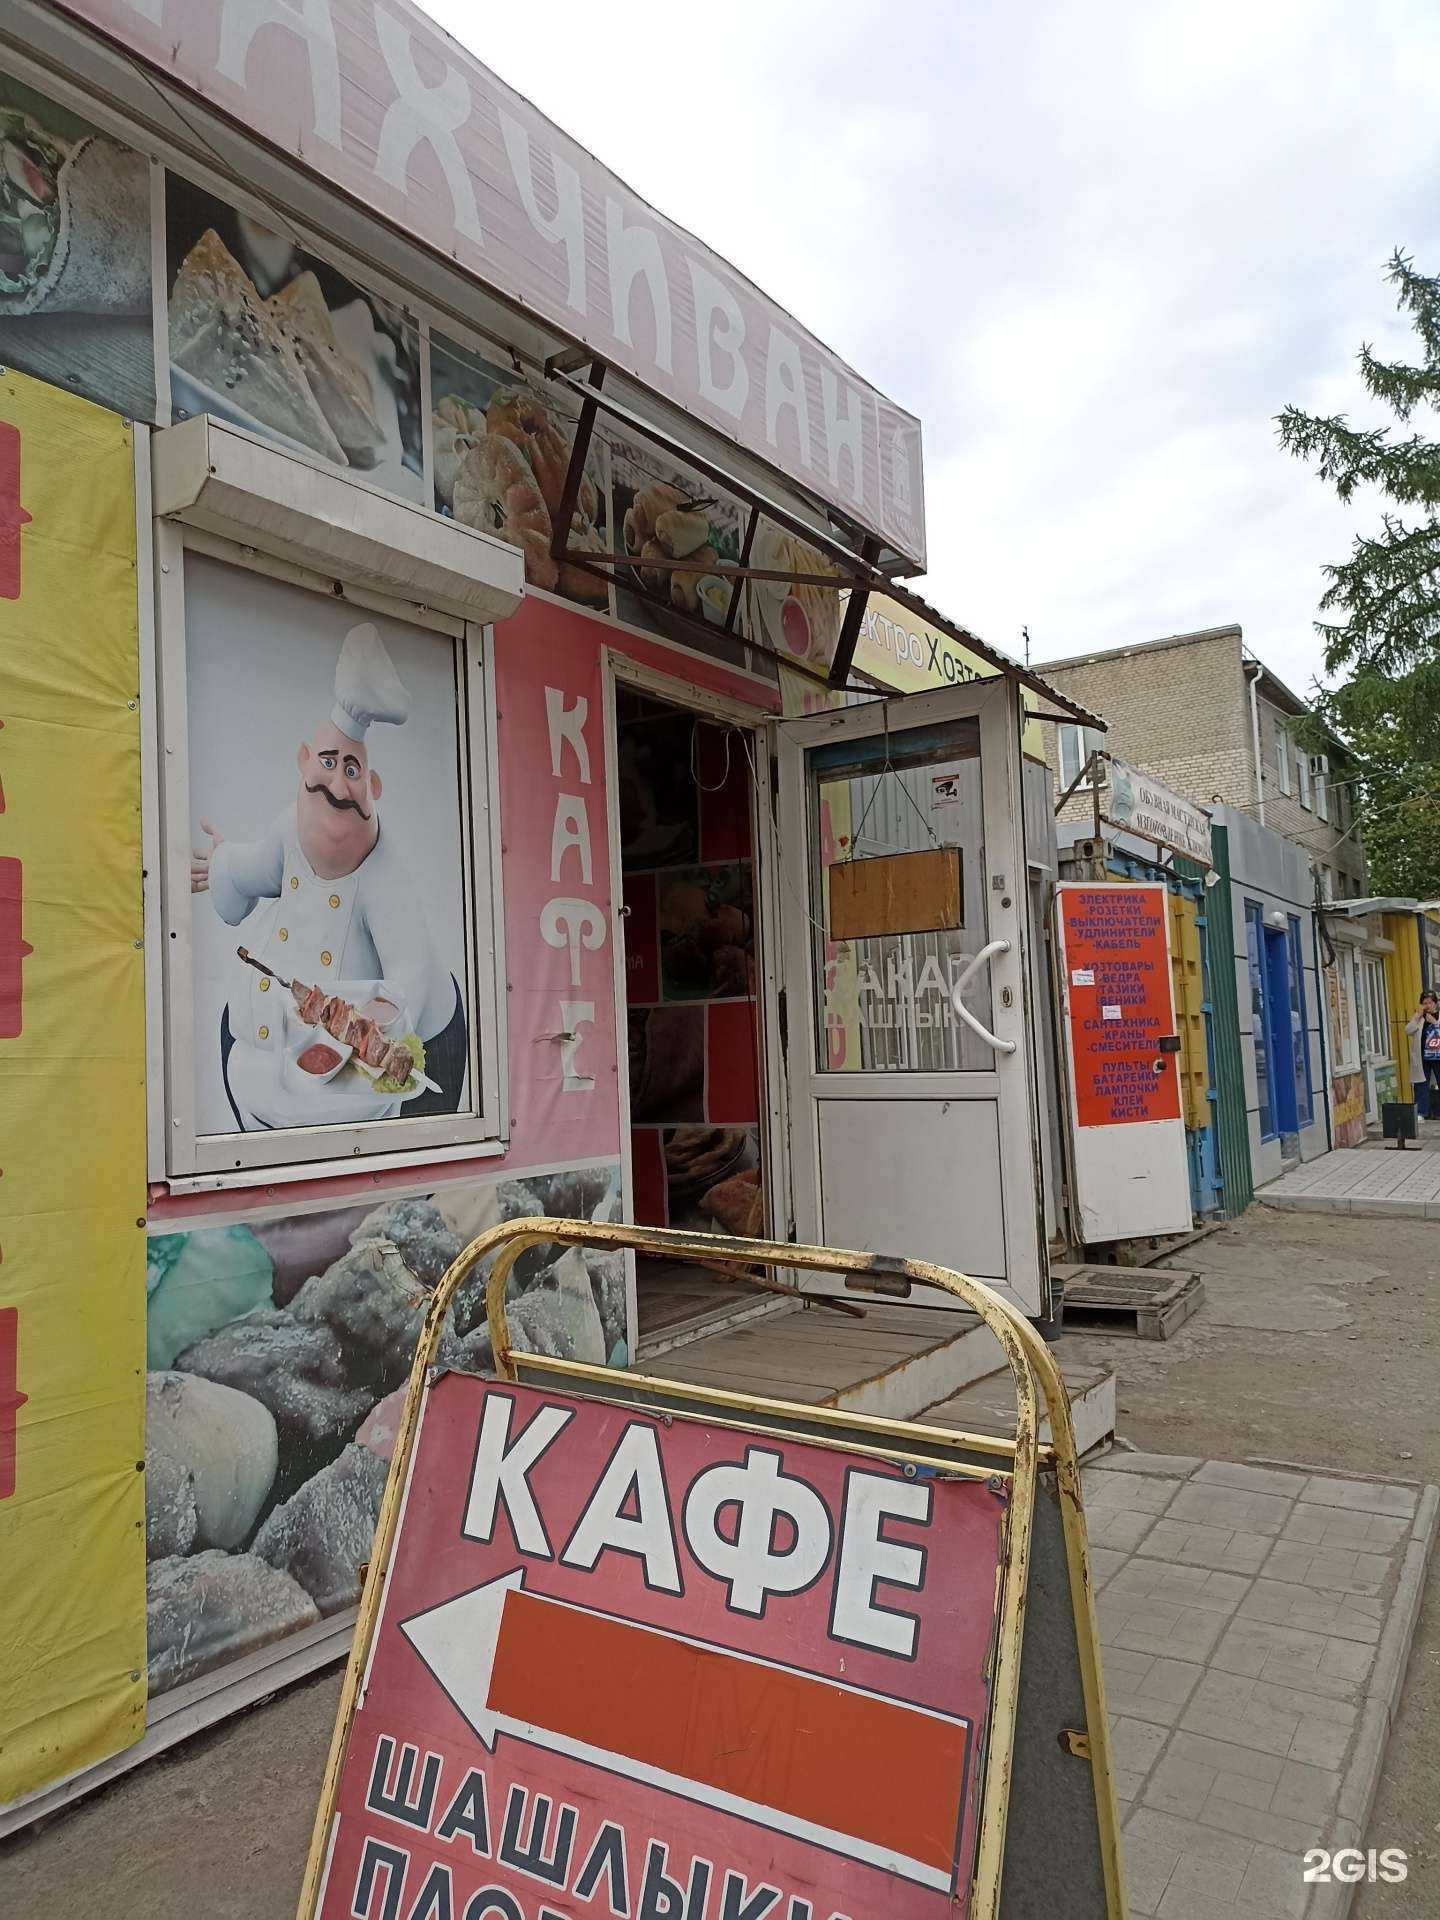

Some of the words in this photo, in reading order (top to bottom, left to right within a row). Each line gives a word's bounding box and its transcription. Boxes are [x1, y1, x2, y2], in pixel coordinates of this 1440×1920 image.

[121, 0, 864, 505] АХЧИВАН
[540, 685, 607, 1091] КАФЕ
[1078, 893, 1146, 905] ЭЛЕКТРИКА
[1082, 961, 1154, 972] ХОЗТОВАРЫ
[1083, 1017, 1160, 1030] САНТЕХНИКА
[1095, 1082, 1159, 1096] ЛАМПОЧКИ
[1110, 1105, 1149, 1118] КИСТИ
[461, 1391, 934, 1662] КАФЕ
